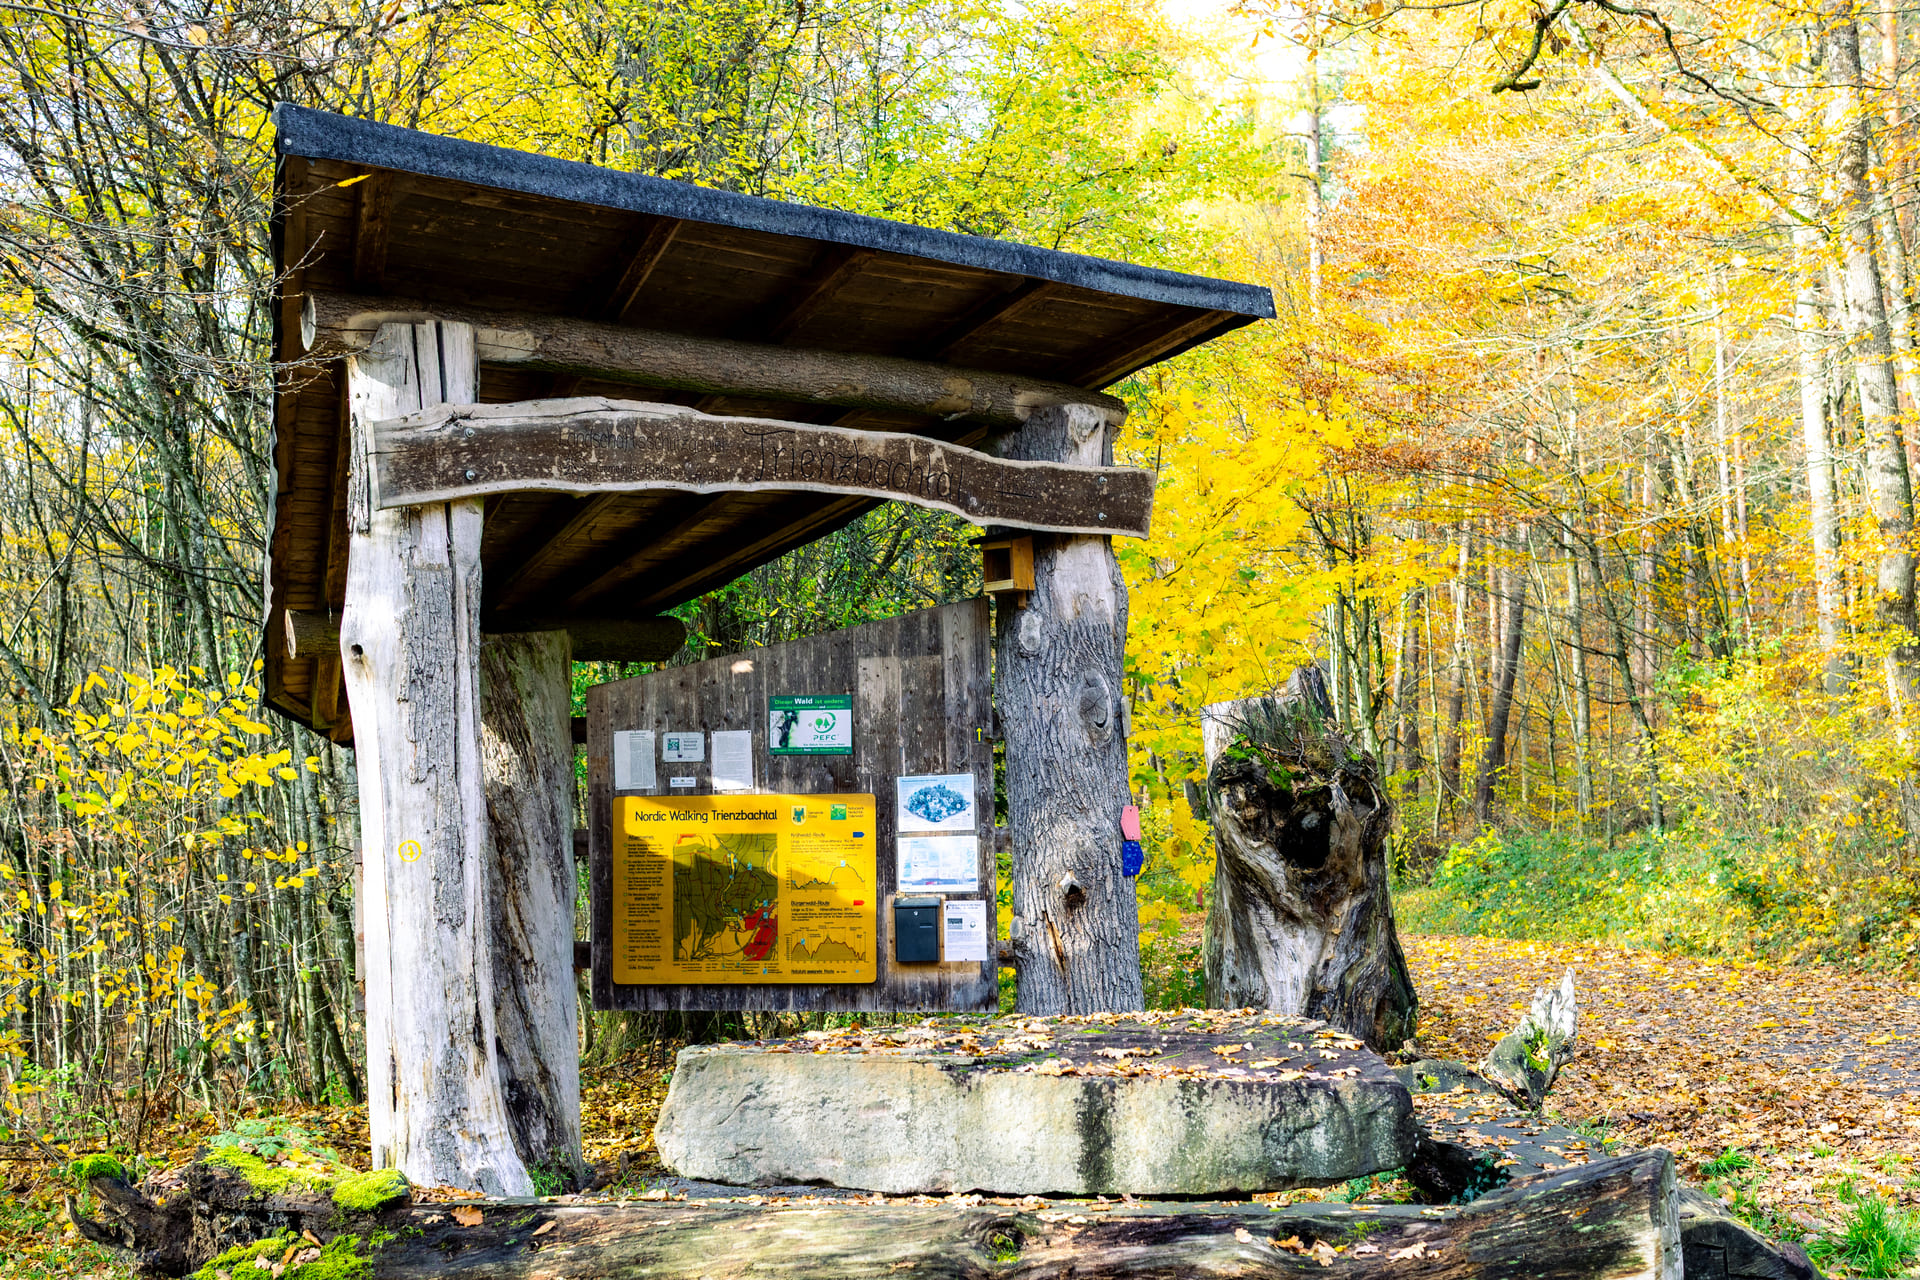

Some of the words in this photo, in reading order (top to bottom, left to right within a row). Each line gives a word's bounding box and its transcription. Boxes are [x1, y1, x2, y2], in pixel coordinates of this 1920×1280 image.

[741, 426, 964, 502] Trienzbachtal
[794, 697, 813, 705] Wald
[635, 811, 667, 822] Nordic
[669, 810, 708, 824] Walking
[711, 809, 778, 822] Trienzbachtal
